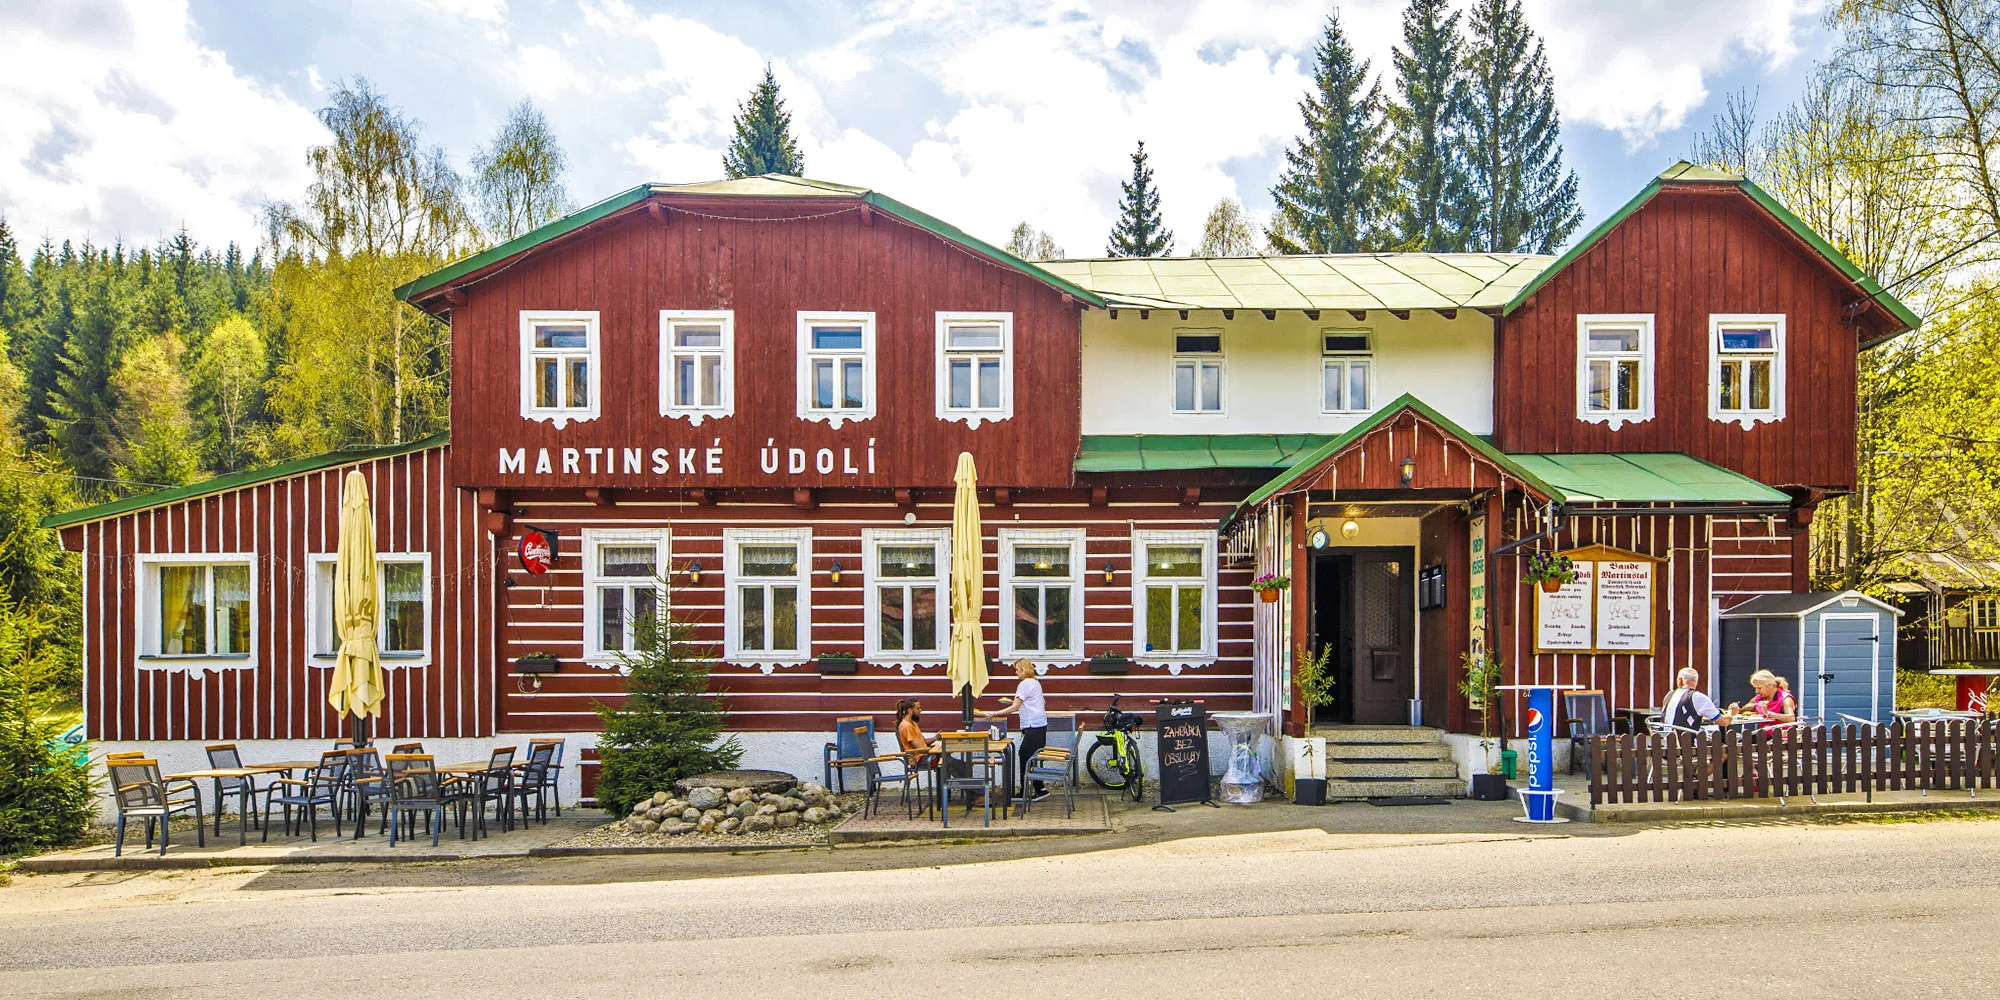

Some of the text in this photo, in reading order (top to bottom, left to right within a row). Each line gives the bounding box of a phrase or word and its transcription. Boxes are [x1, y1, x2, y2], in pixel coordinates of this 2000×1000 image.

[498, 437, 876, 474] MARTINSKÉ ÚDOLÍ
[1174, 739, 1195, 750] BEZ
[1528, 736, 1541, 788] pepsi
